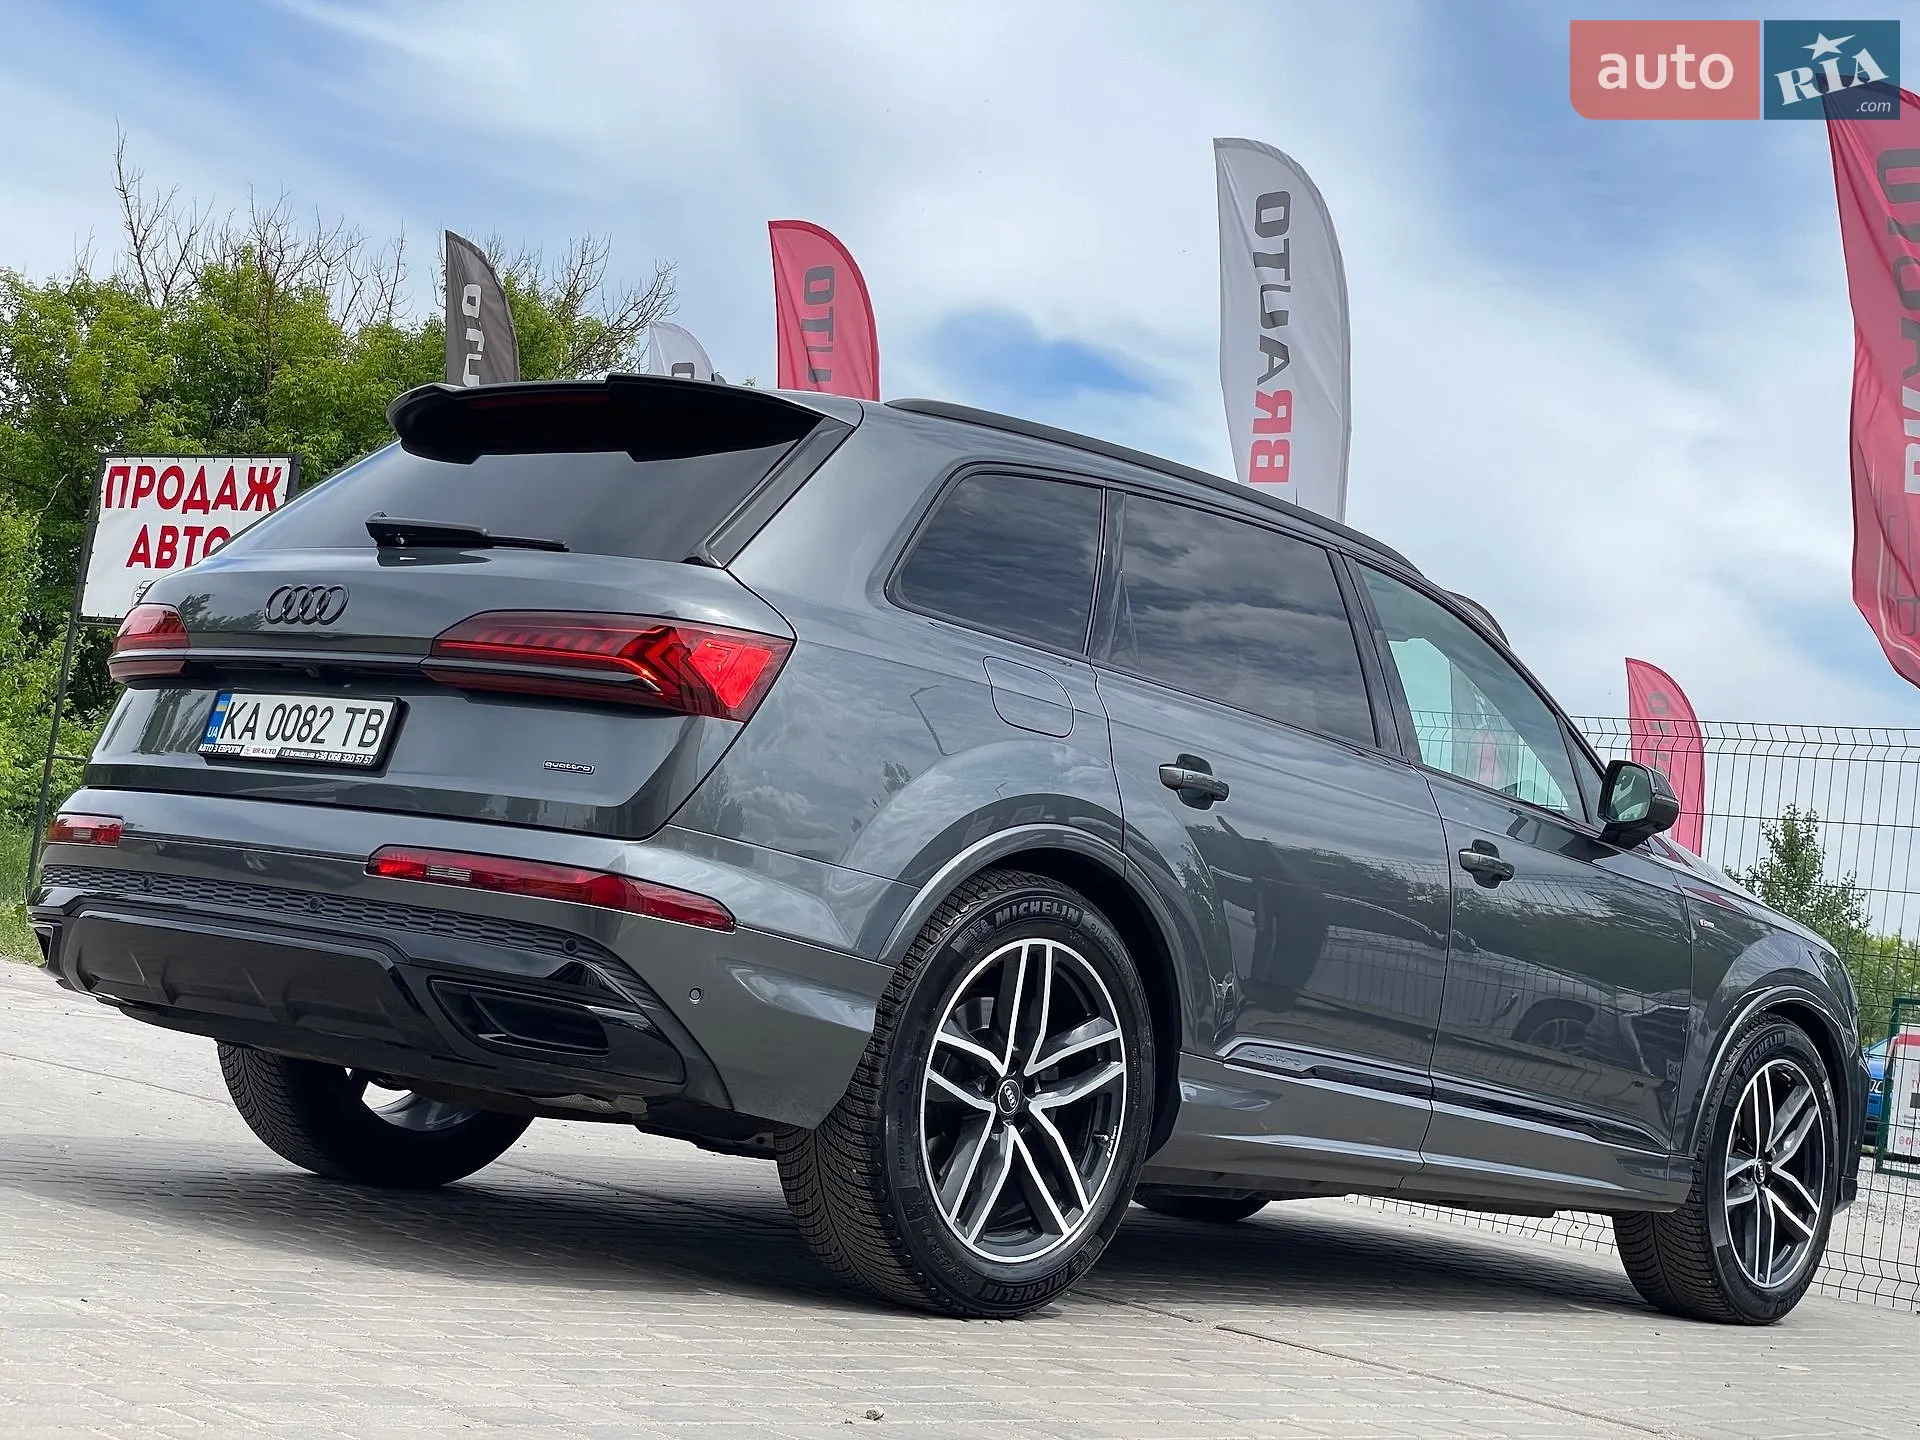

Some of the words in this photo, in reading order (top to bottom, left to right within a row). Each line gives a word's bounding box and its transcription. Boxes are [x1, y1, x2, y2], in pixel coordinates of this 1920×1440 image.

[104, 465, 283, 514] ПРОДАЖ
[125, 524, 232, 569] АВТО
[207, 726, 218, 738] UA
[220, 701, 261, 740] KA
[265, 703, 335, 743] 0082
[342, 707, 385, 748] TB
[545, 761, 591, 771] quattro
[995, 900, 1080, 926] MICHELIN
[1742, 1032, 1785, 1076] MICHELIN
